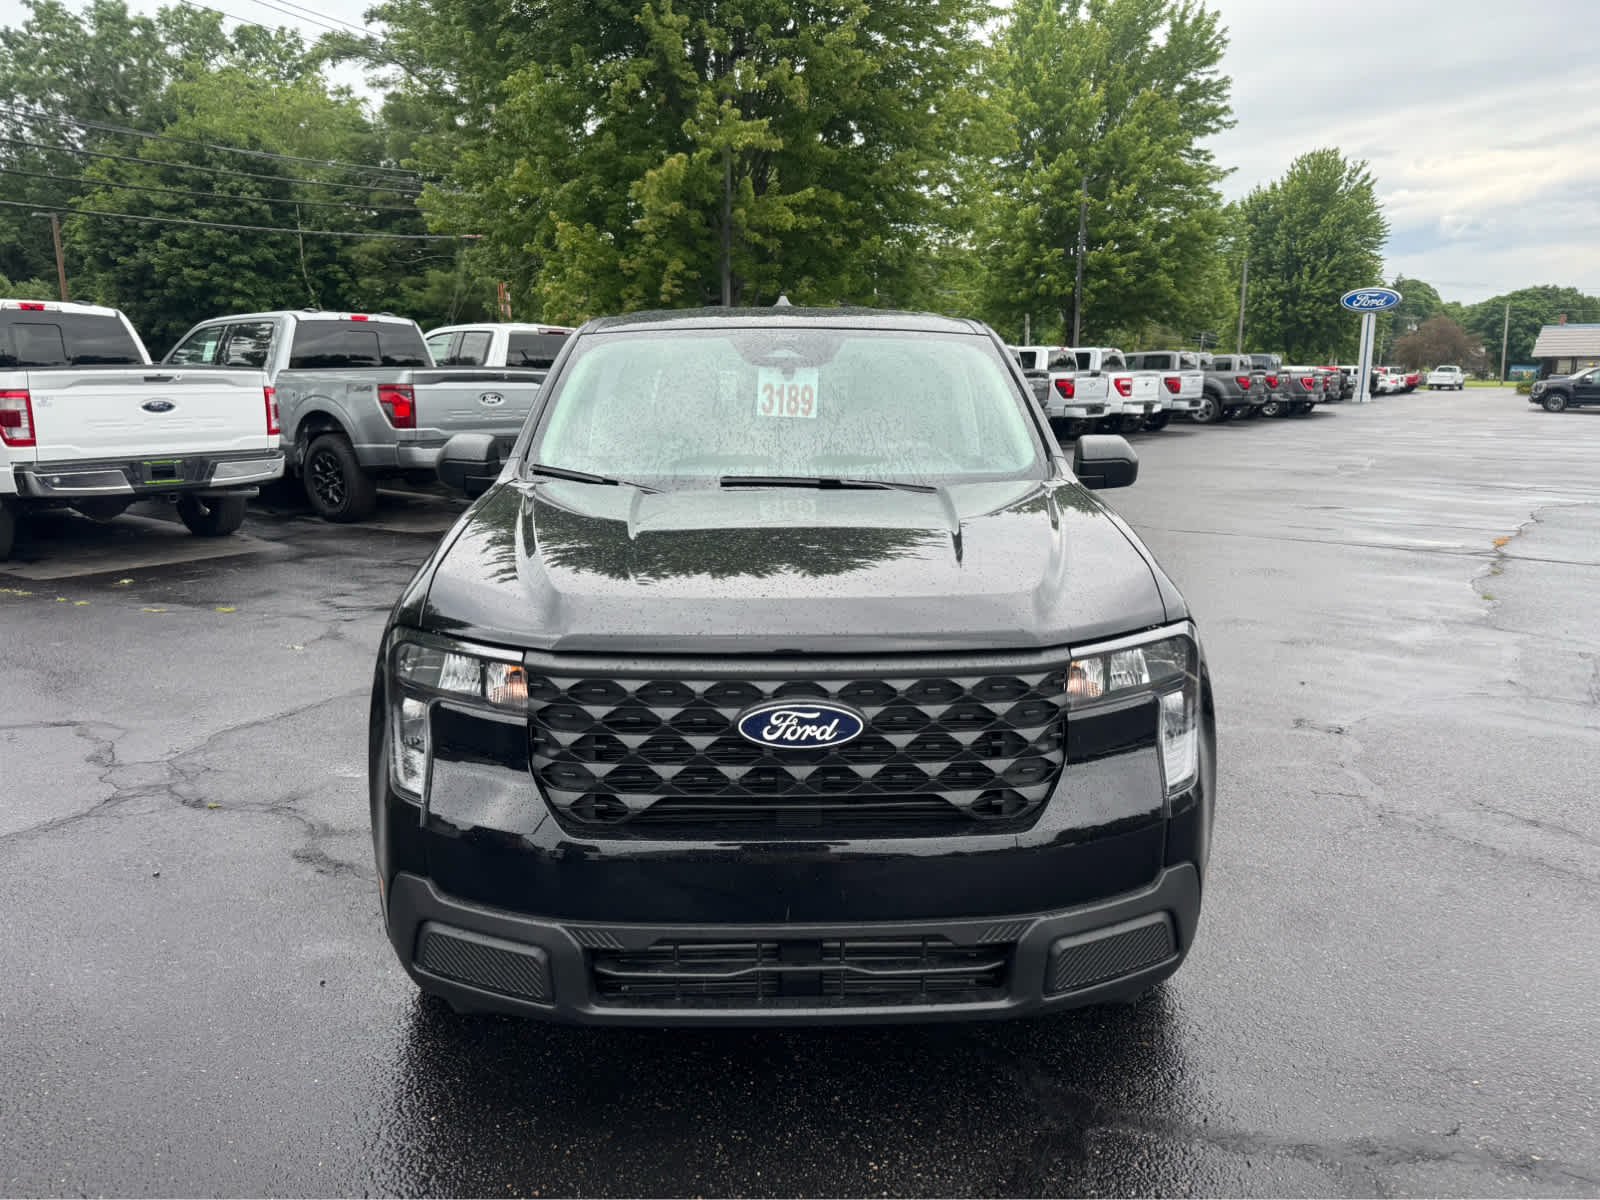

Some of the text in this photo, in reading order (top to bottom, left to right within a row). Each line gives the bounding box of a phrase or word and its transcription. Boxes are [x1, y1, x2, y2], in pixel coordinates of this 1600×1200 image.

[1353, 294, 1388, 307] Ford
[761, 383, 814, 416] 3189
[762, 710, 839, 740] Ford
